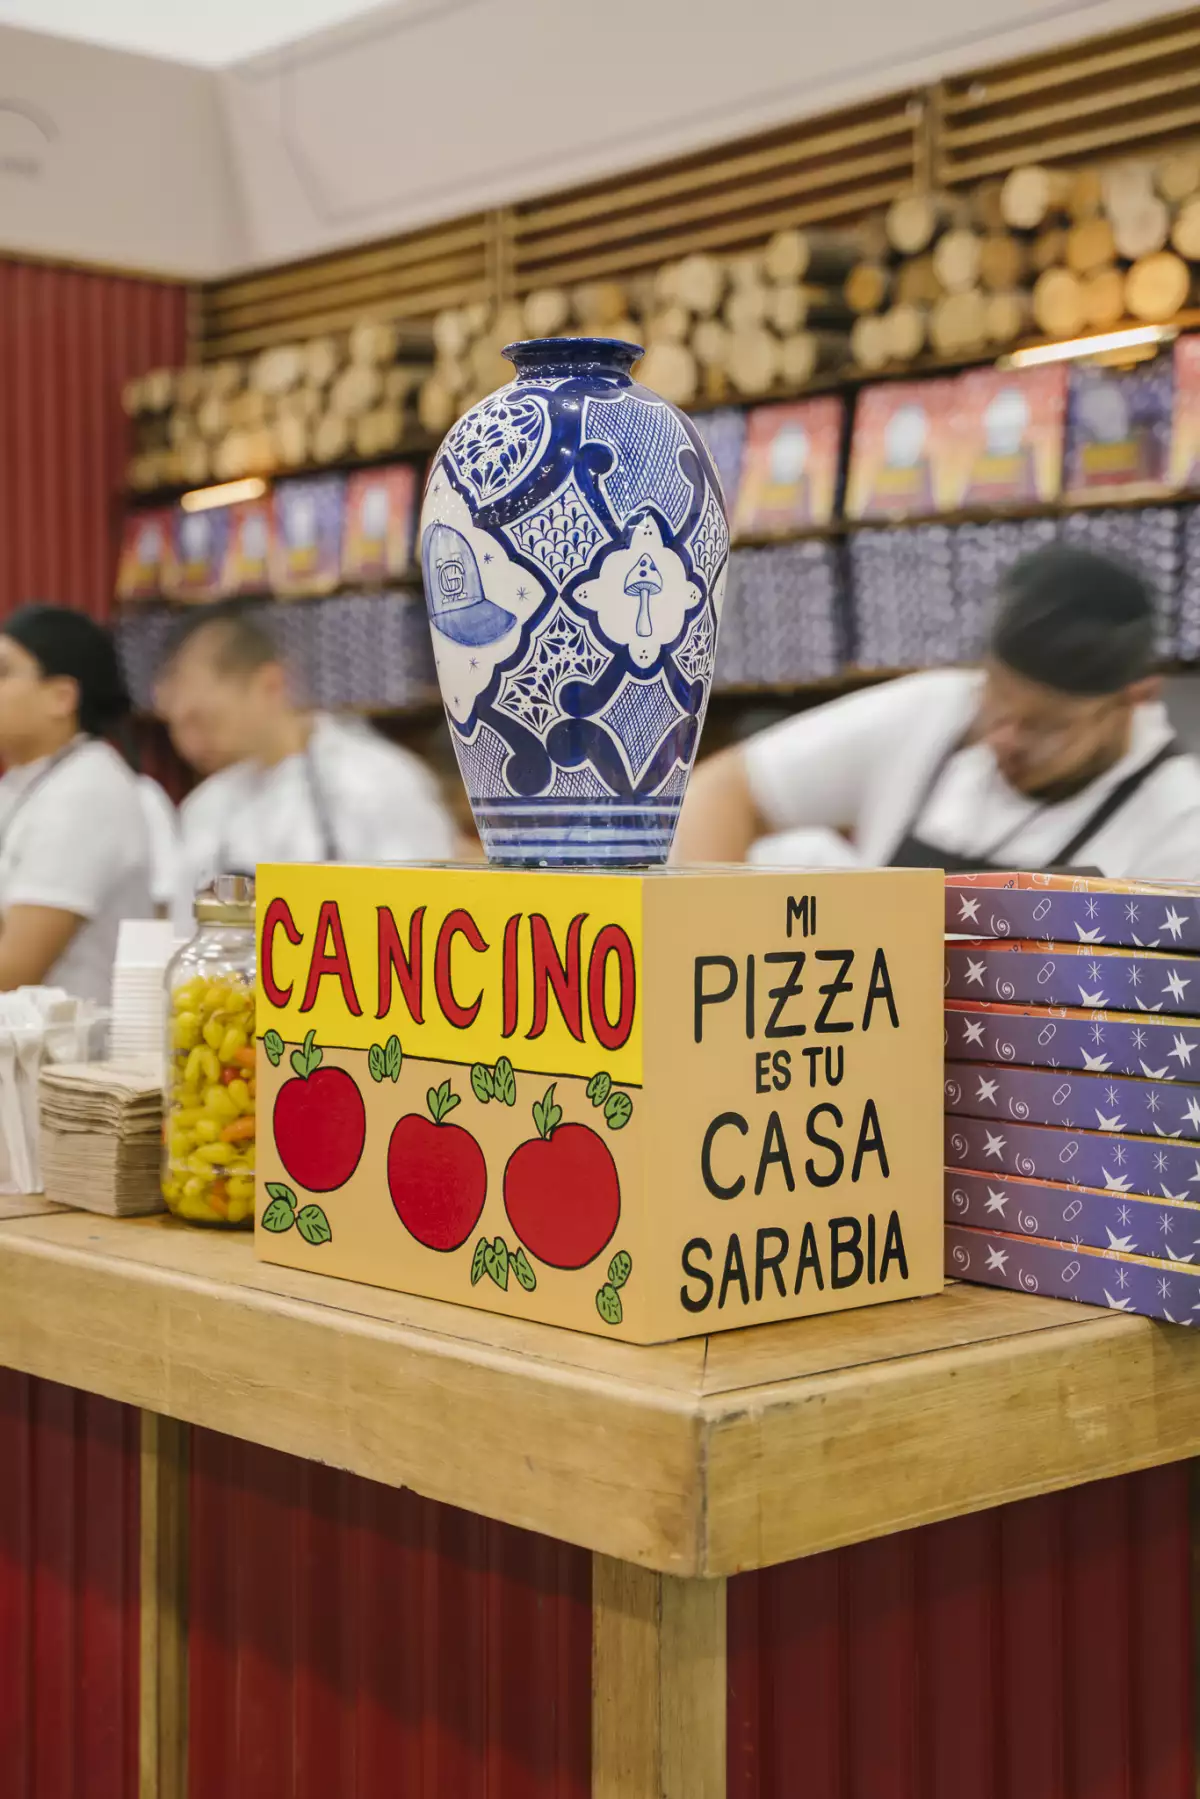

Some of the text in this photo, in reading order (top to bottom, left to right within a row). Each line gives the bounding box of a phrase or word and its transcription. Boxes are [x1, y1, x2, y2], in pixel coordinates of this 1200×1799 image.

[786, 895, 816, 938] MI
[261, 897, 636, 1051] CANCINO
[694, 948, 900, 1044] PIZZA
[755, 1045, 844, 1094] ES TU
[701, 1098, 890, 1201] CASA
[680, 1210, 909, 1313] SARABIA
